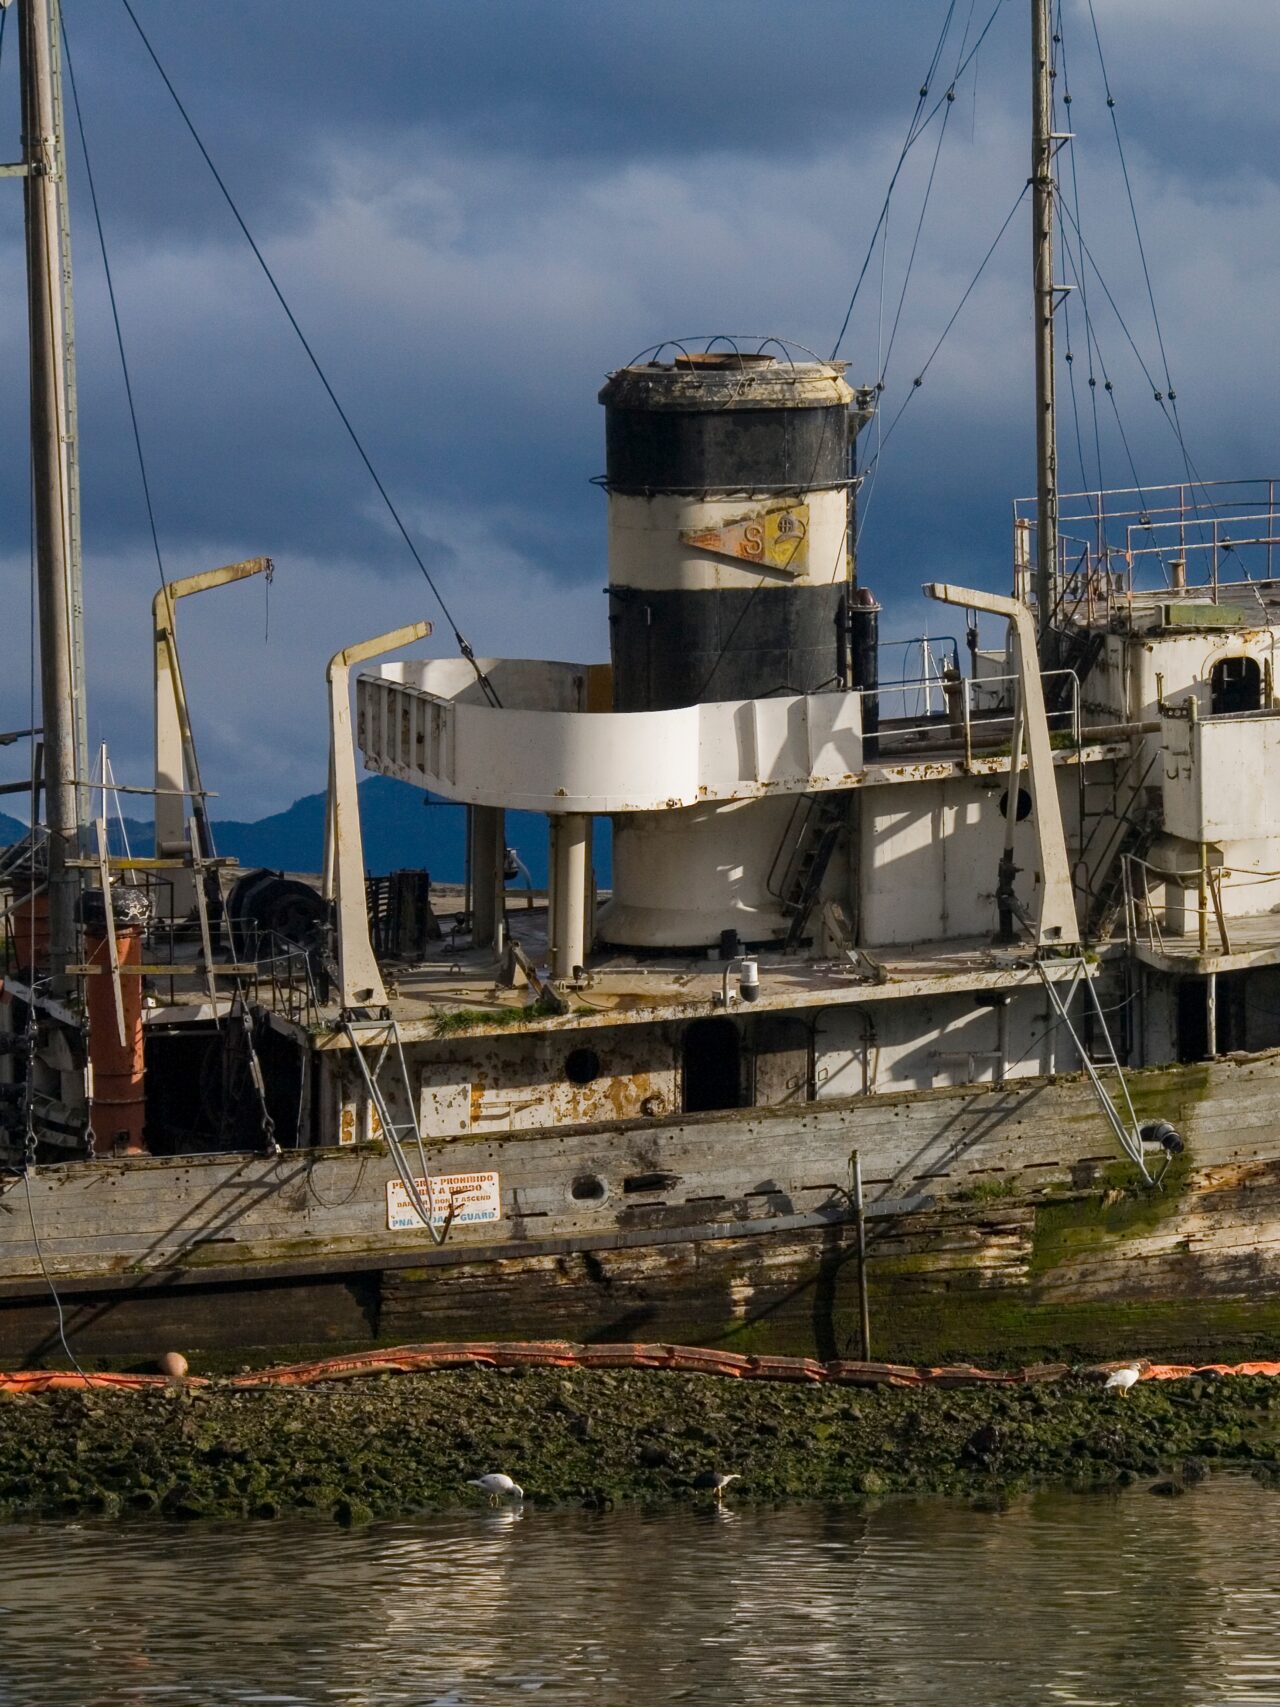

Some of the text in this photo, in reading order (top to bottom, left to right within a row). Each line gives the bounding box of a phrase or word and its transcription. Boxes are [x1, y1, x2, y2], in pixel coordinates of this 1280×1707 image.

[392, 1180, 433, 1189] PEGR
[440, 1175, 494, 1185] PROHIBIDO
[397, 1200, 428, 1208] DANR
[392, 1219, 413, 1227] PNA
[460, 1212, 495, 1221] GUARD
